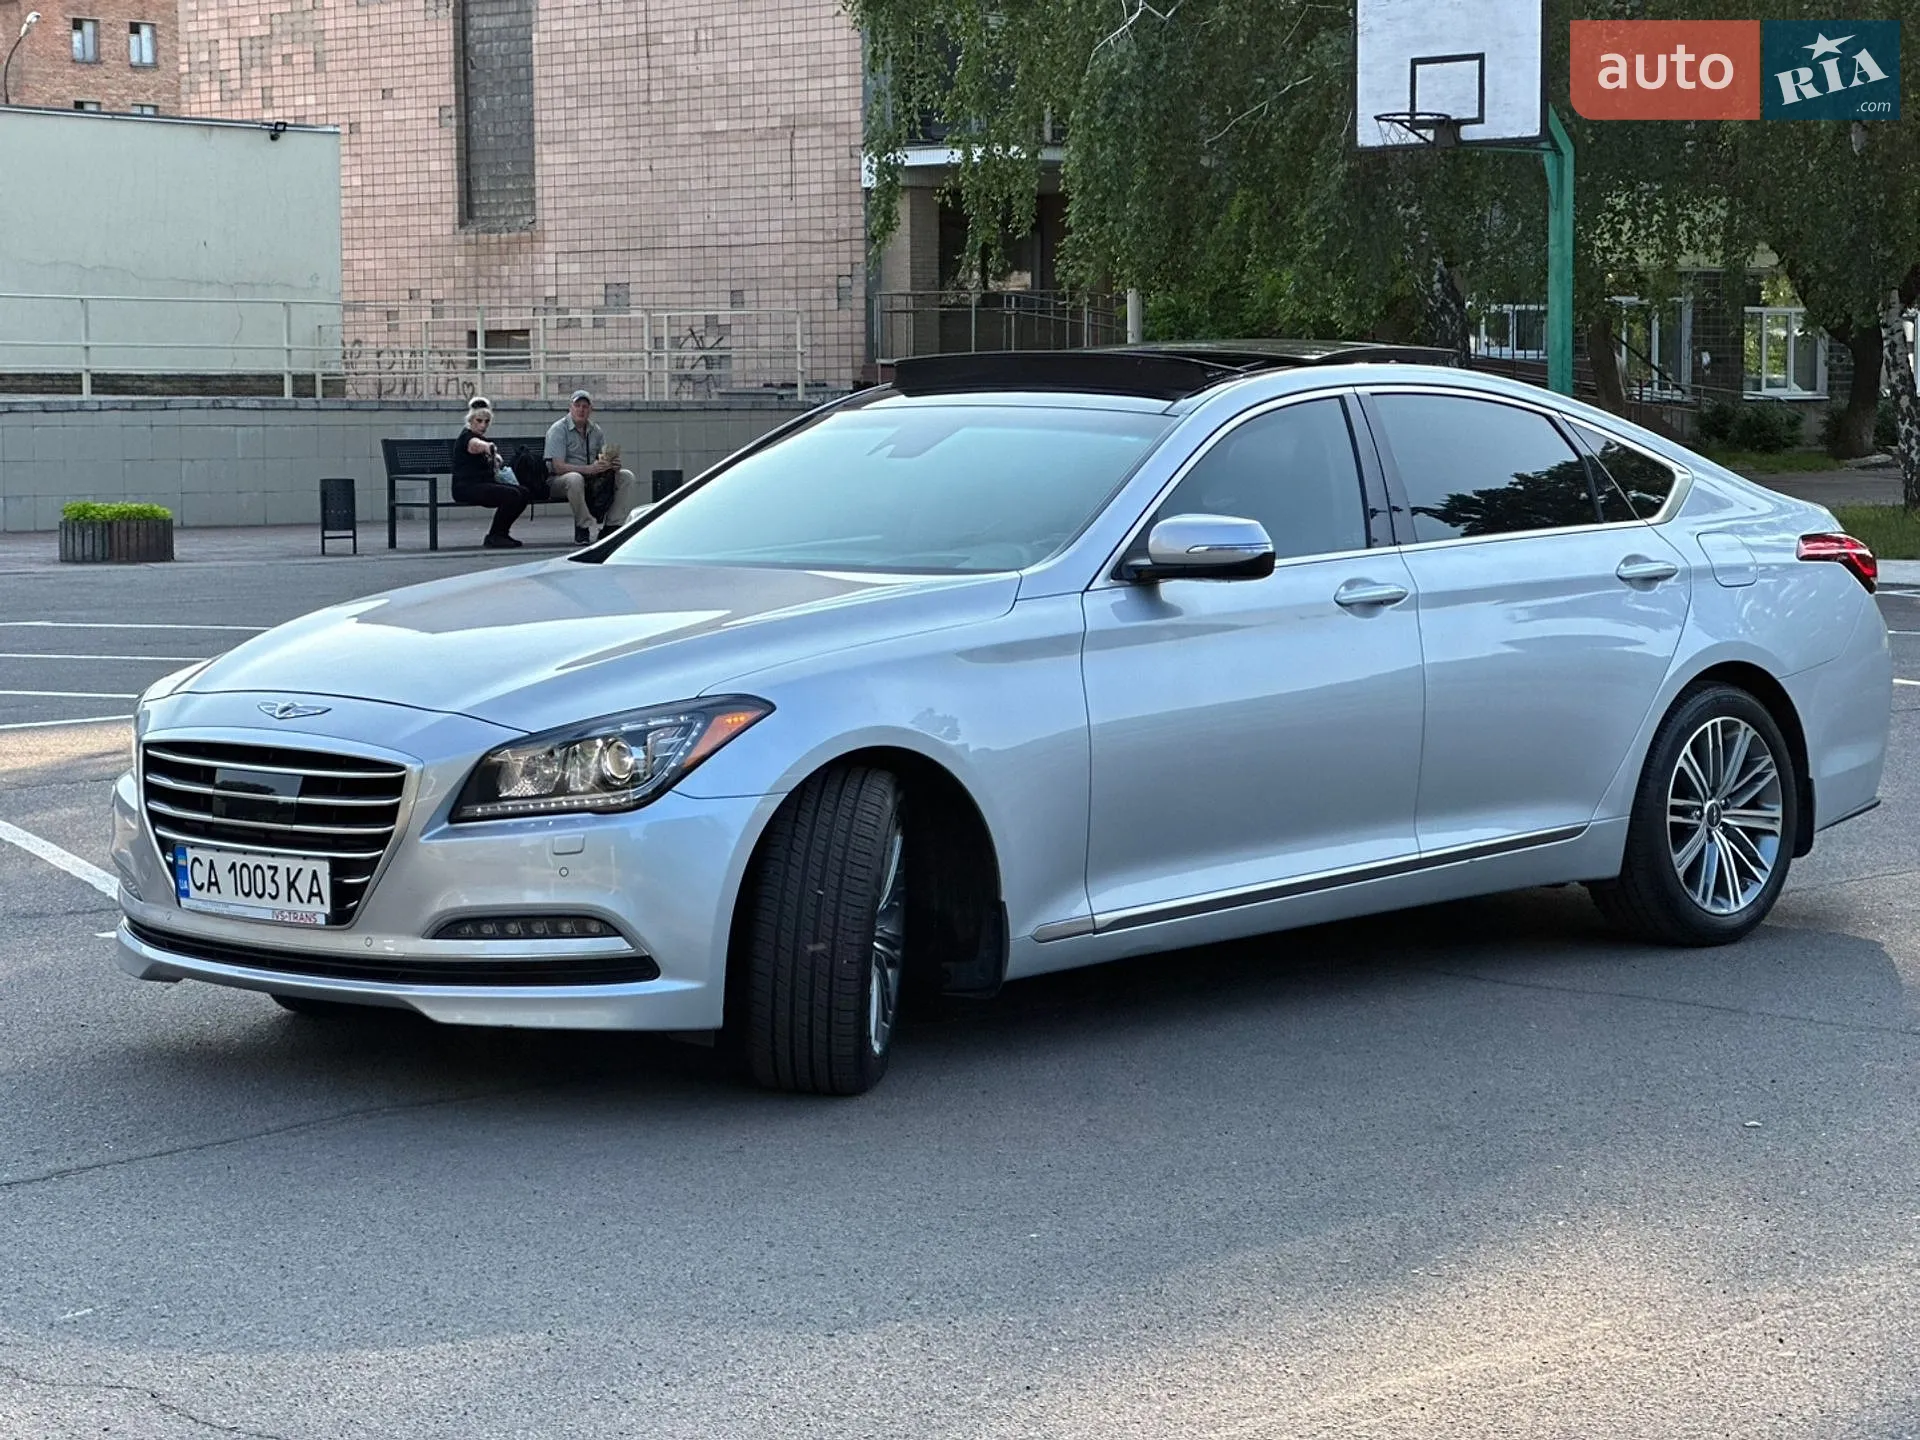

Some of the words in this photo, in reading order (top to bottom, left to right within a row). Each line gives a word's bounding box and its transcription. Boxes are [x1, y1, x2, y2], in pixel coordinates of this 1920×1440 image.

[190, 856, 222, 894] CA
[227, 861, 280, 900] 1003
[286, 867, 325, 904] KA
